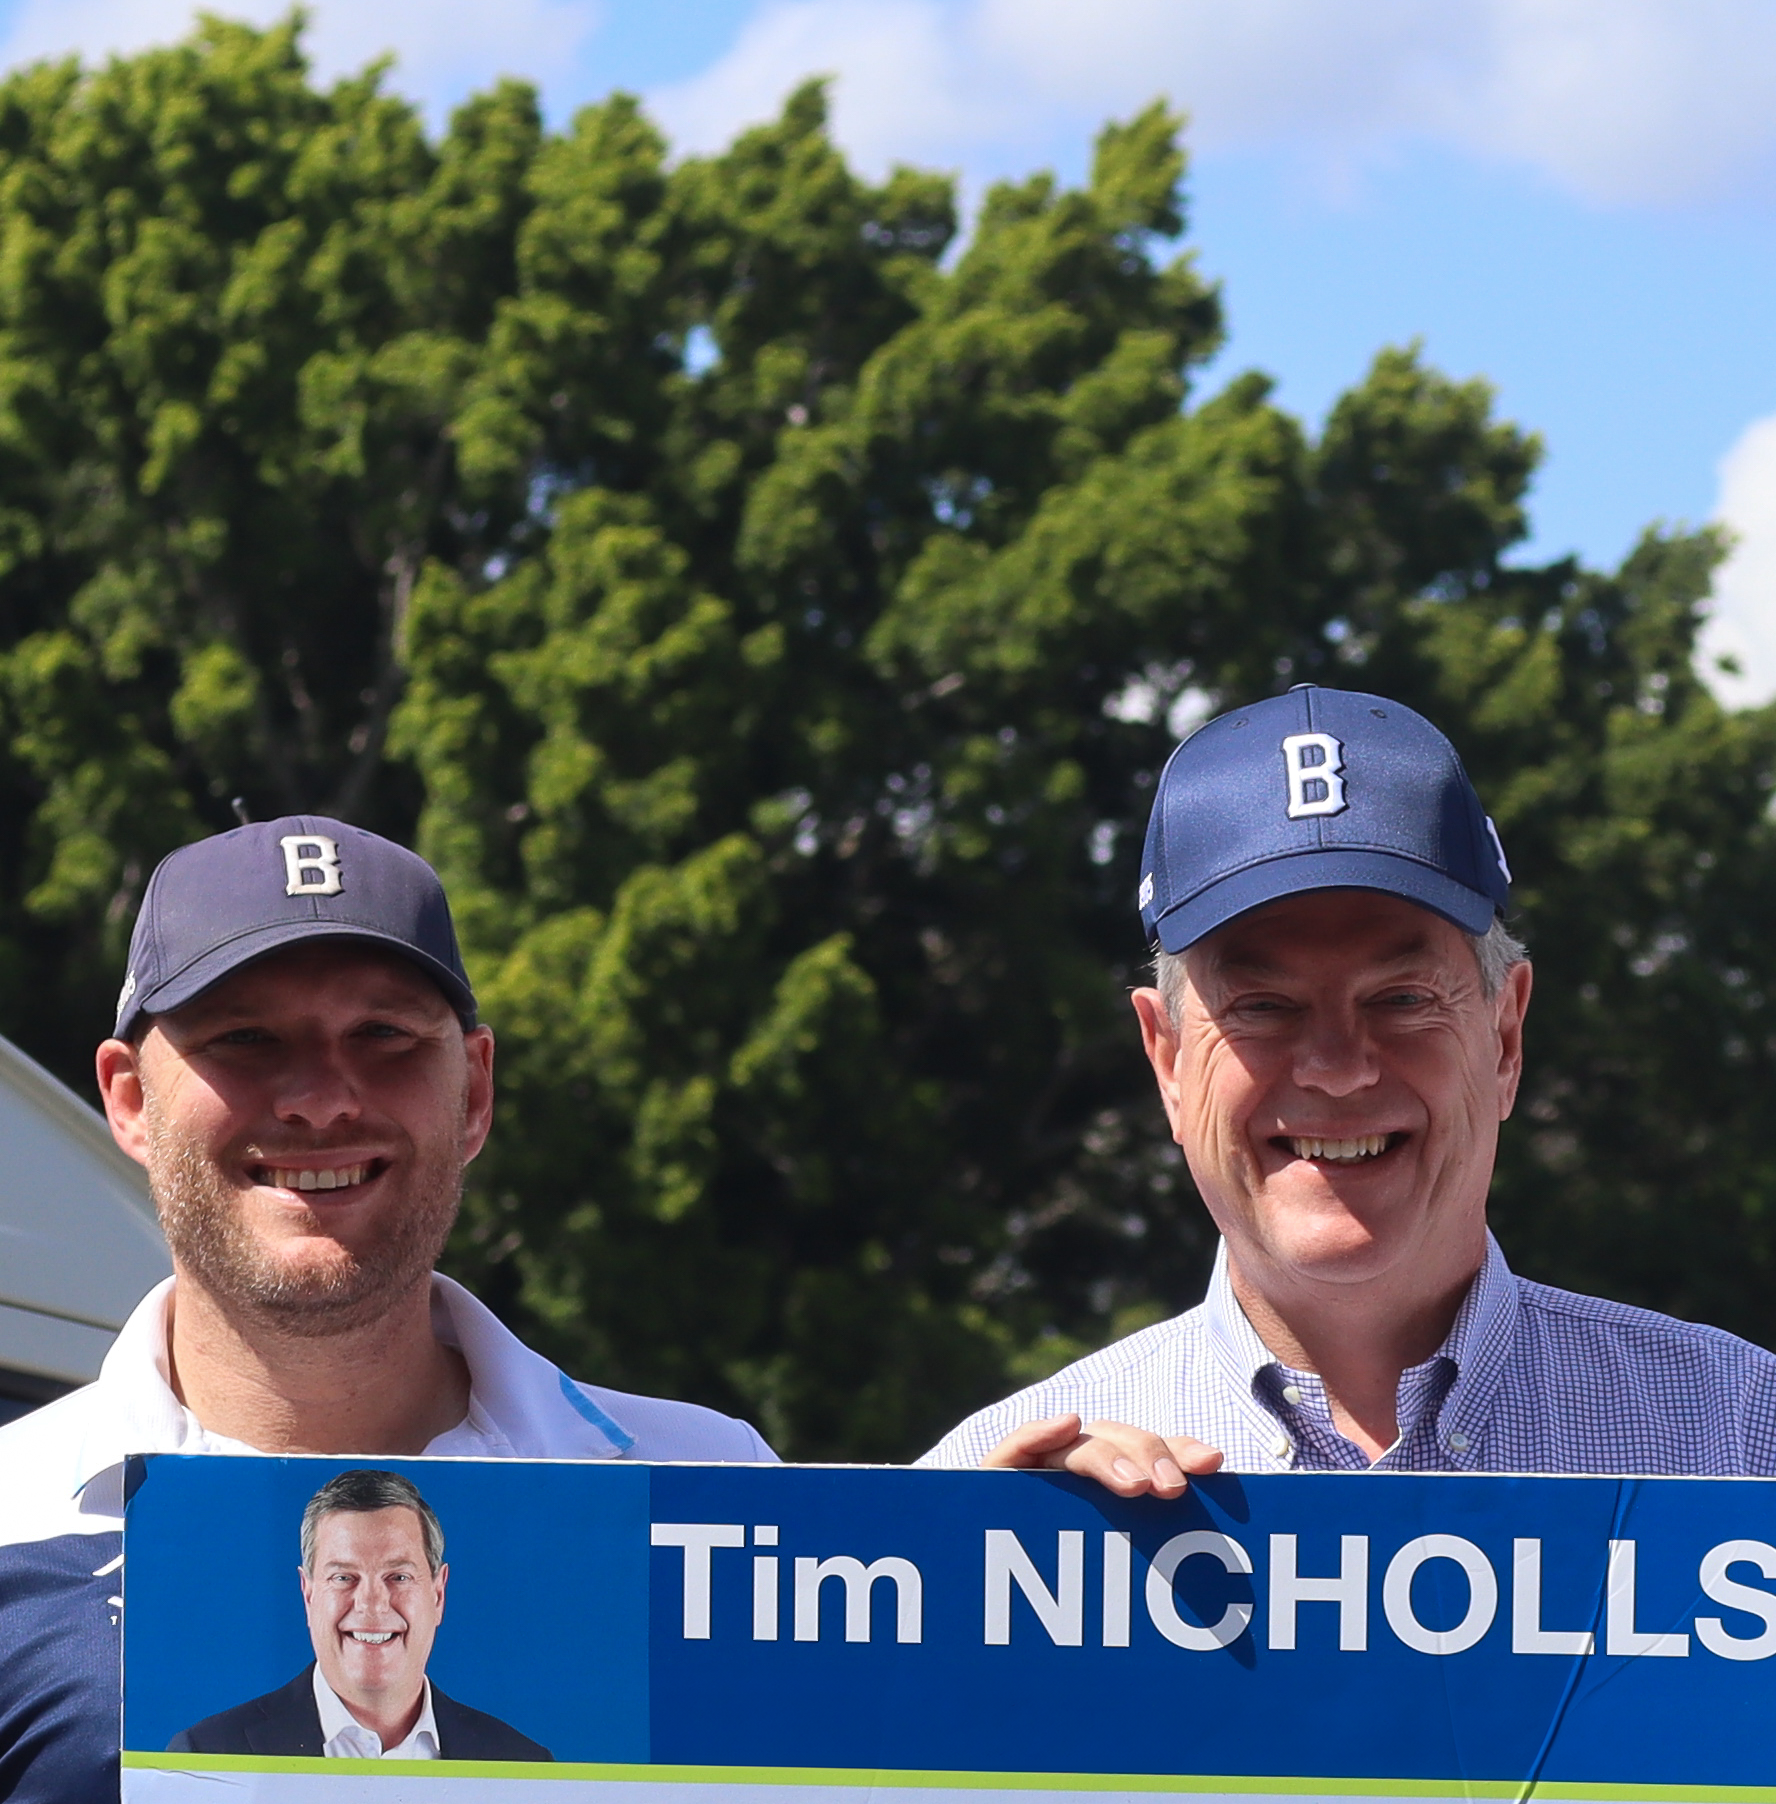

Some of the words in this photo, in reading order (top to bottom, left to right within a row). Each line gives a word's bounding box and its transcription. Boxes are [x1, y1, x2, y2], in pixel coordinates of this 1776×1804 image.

[1283, 733, 1351, 819] B
[280, 834, 345, 897] B
[650, 1523, 924, 1643] Tim
